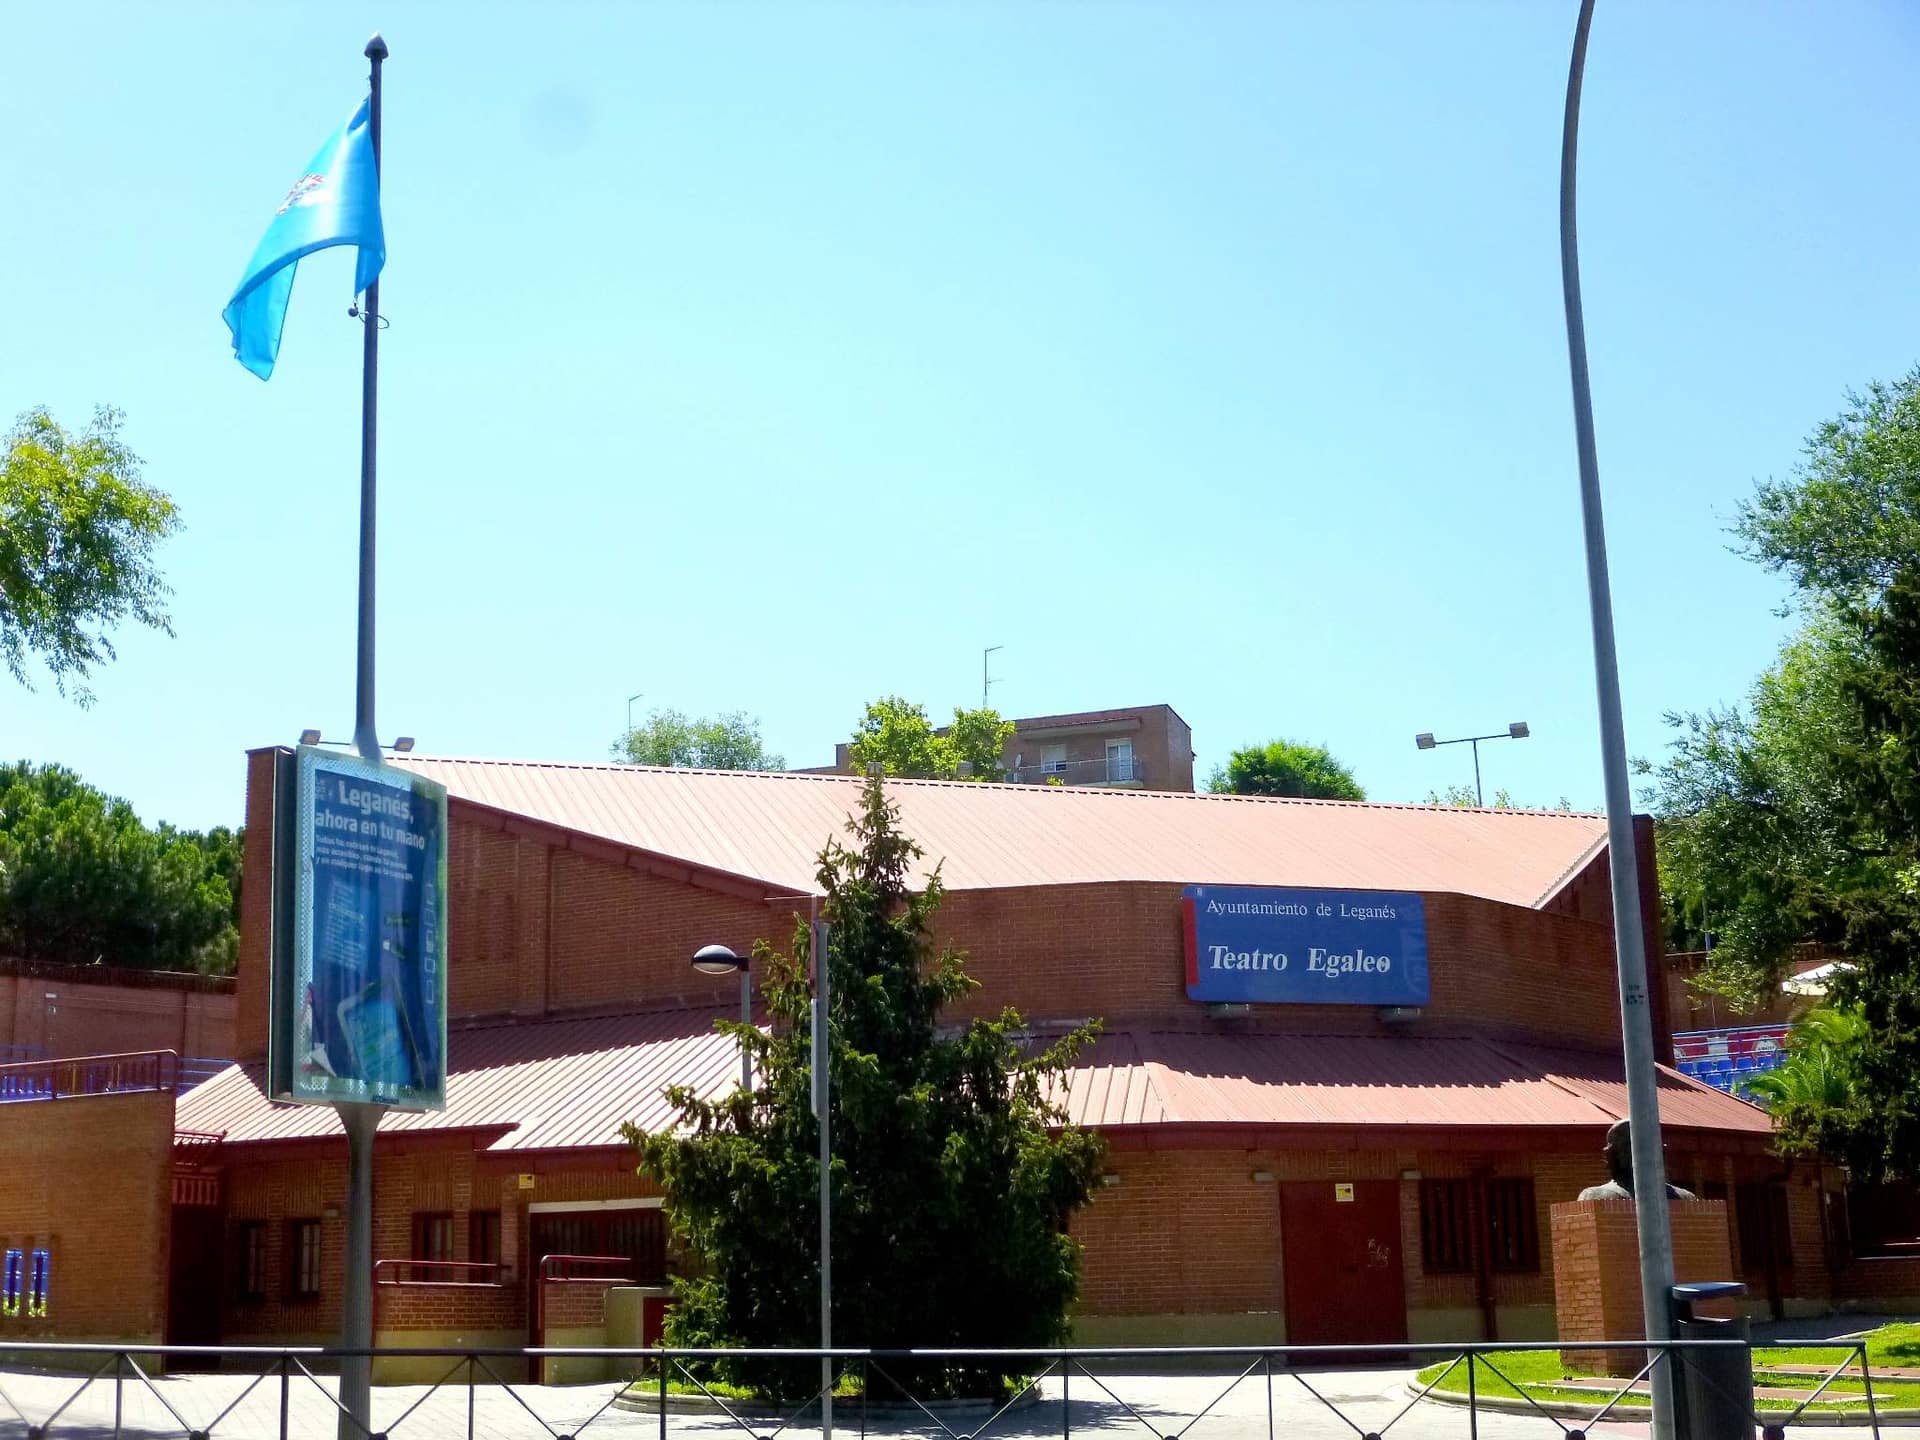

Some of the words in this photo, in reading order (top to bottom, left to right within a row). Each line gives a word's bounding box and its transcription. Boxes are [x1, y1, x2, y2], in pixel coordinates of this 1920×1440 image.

[315, 808, 358, 833] ahora
[360, 820, 378, 837] en
[380, 821, 394, 841] tu
[396, 829, 426, 850] mano
[1205, 899, 1308, 917] Ayuntamiento
[1315, 902, 1333, 917] de
[1340, 903, 1397, 921] Leganés
[1207, 945, 1289, 972] Teatro
[1305, 947, 1392, 978] Egaleo
